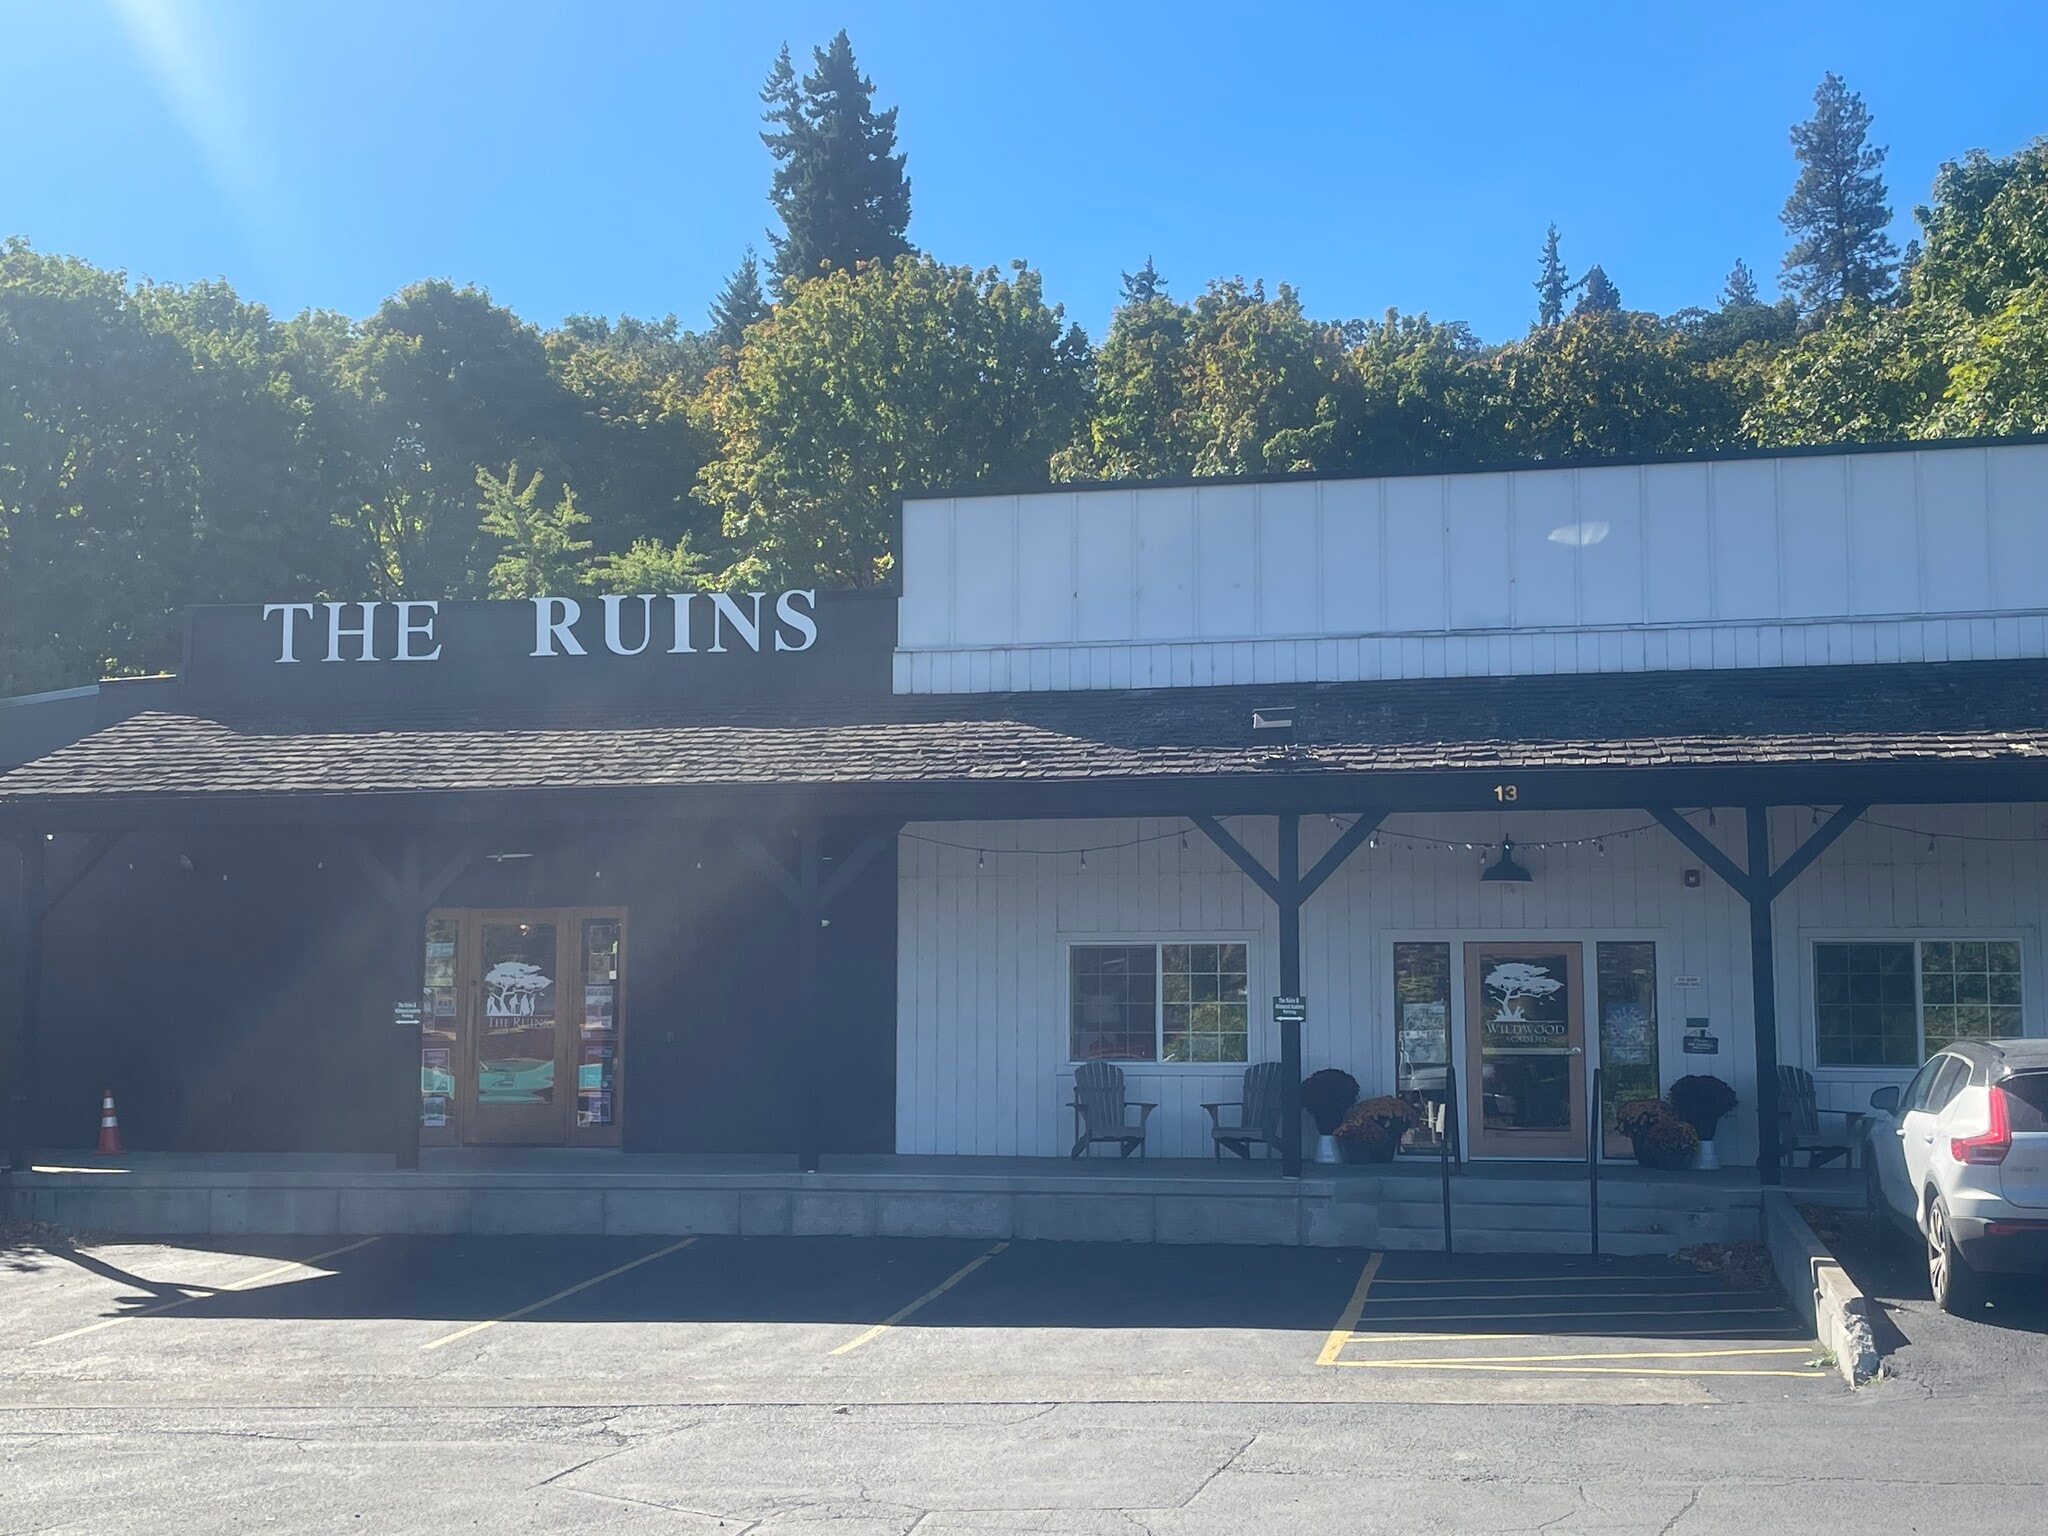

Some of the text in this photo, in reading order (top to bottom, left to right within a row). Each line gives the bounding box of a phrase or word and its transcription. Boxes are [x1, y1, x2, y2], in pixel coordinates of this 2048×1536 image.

[263, 588, 818, 664] THE RUINS
[1493, 785, 1518, 801] 13
[1485, 1022, 1565, 1036] WILDWOOD
